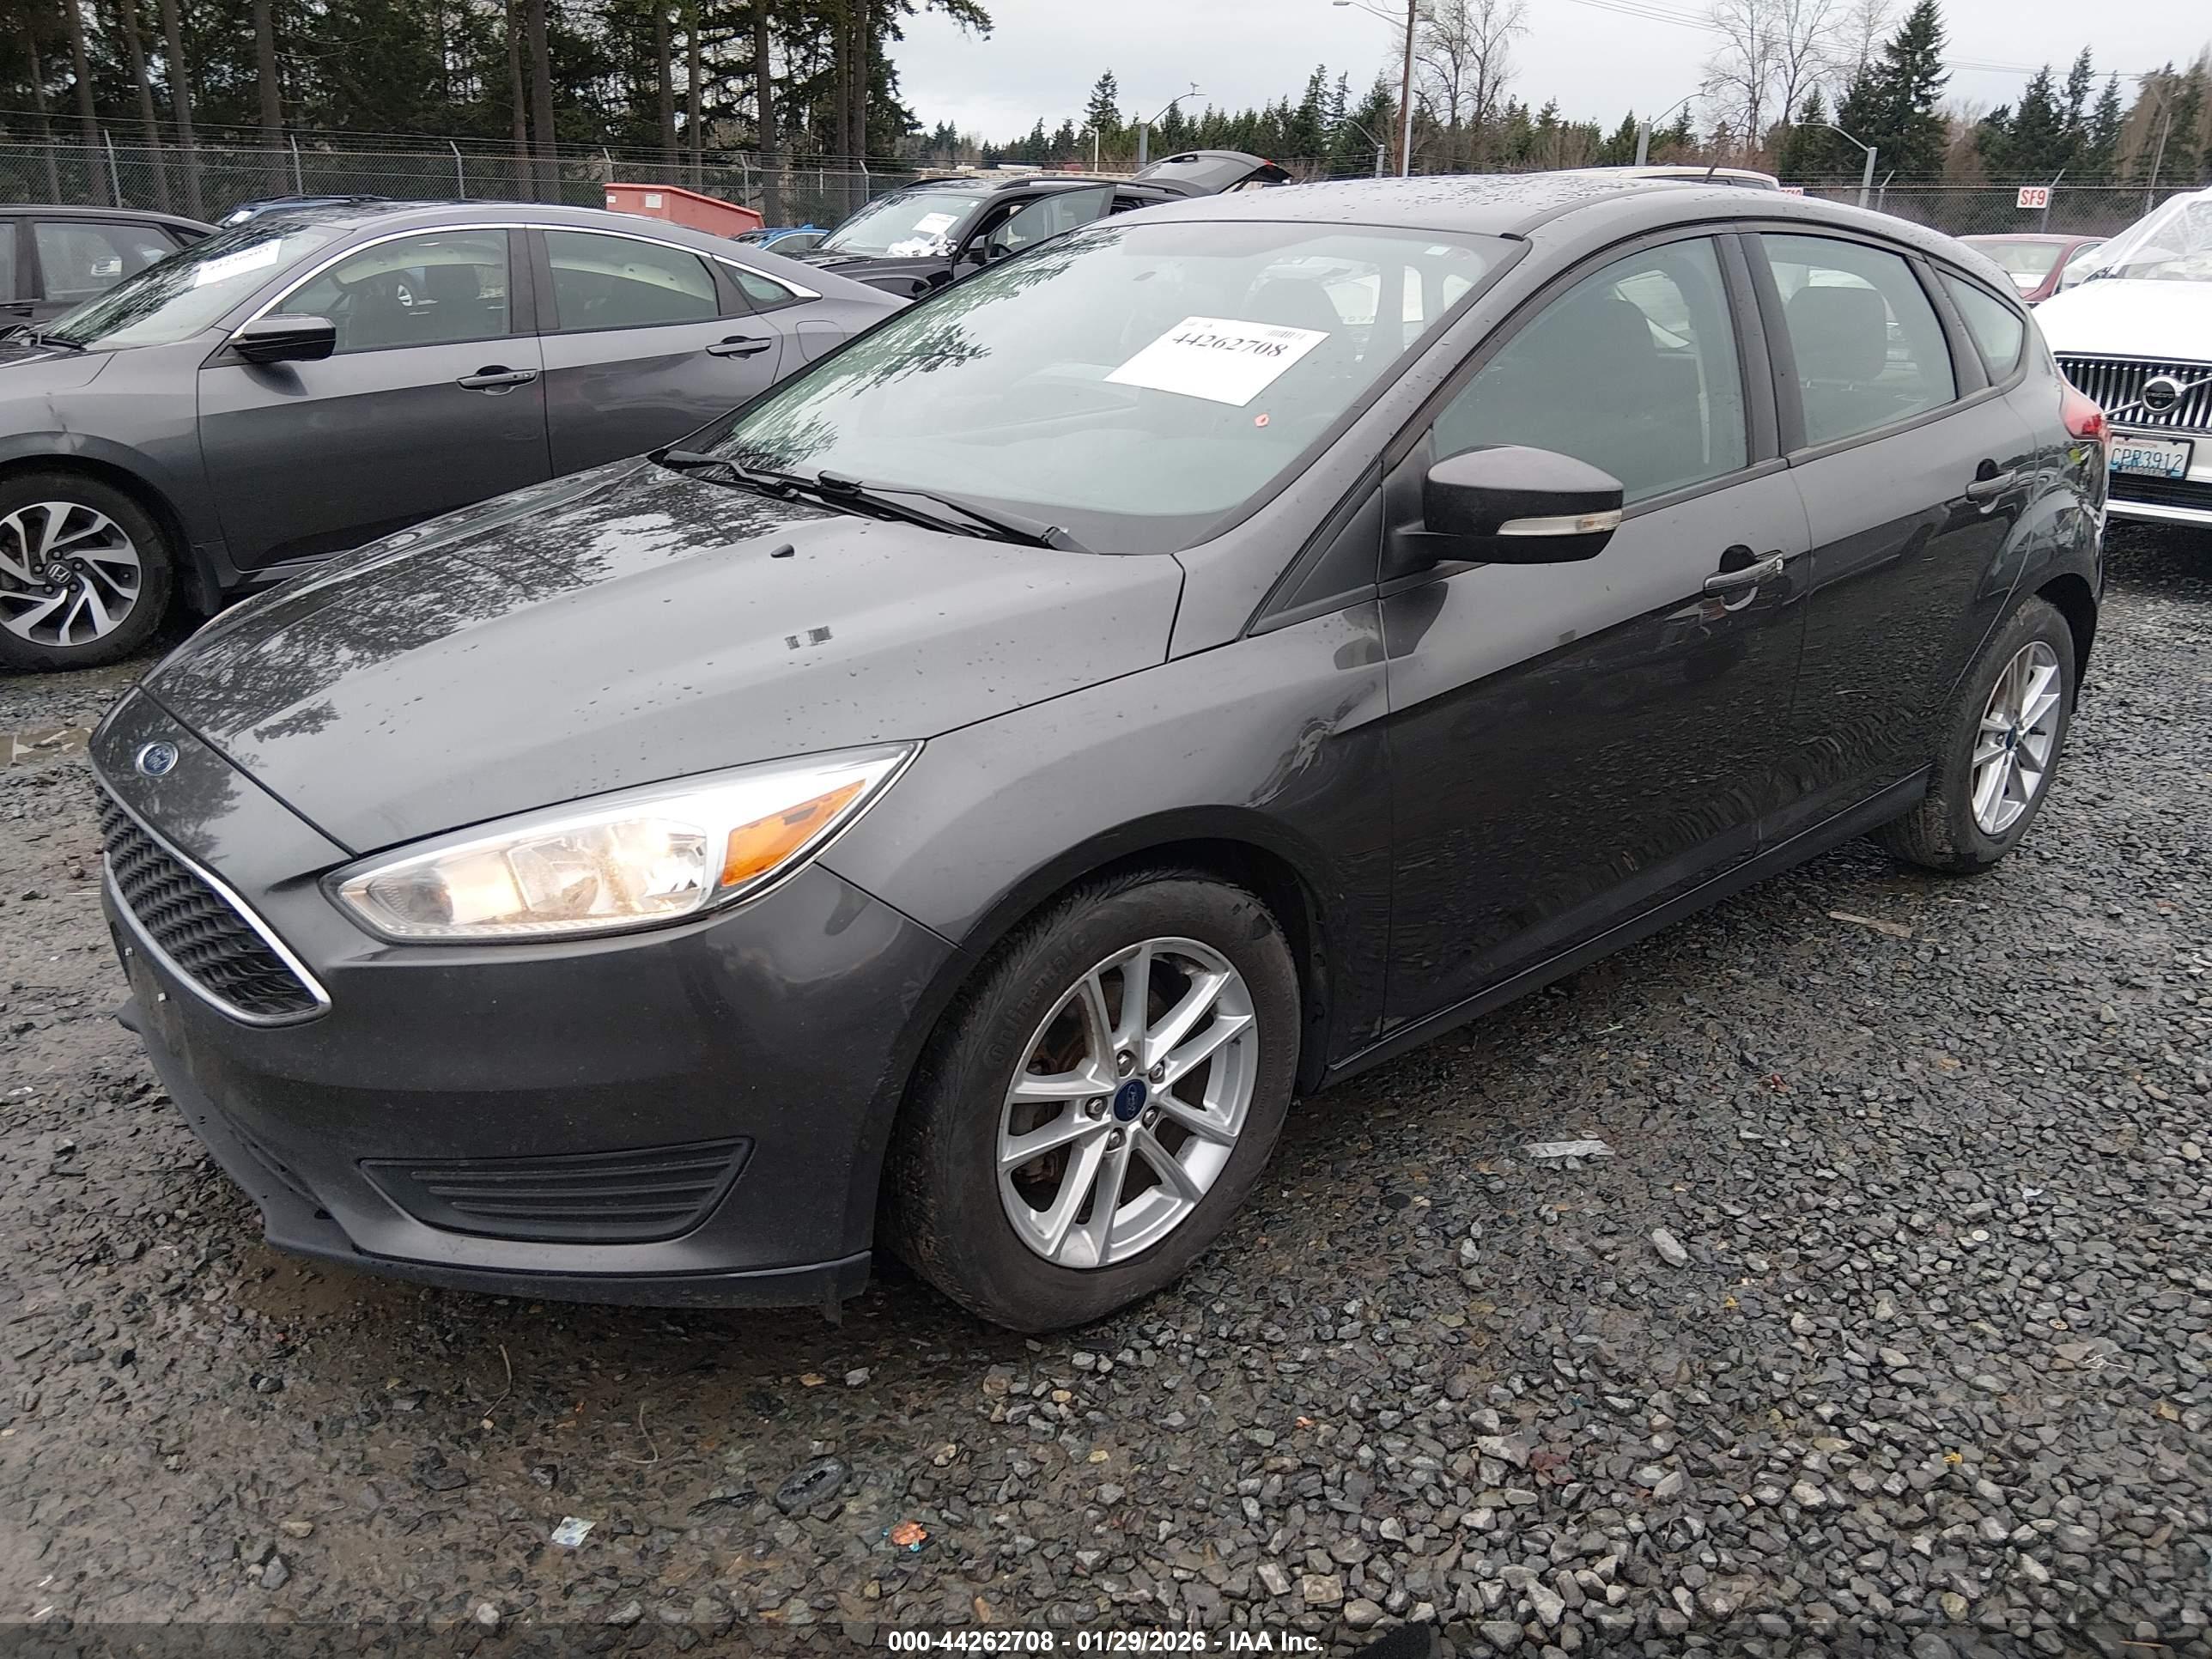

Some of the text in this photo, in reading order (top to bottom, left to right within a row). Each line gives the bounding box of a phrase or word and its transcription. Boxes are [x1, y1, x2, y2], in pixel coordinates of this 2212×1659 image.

[2021, 189, 2045, 205] SF9
[1172, 332, 1288, 356] 44262708
[2110, 447, 2184, 472] CPR3912
